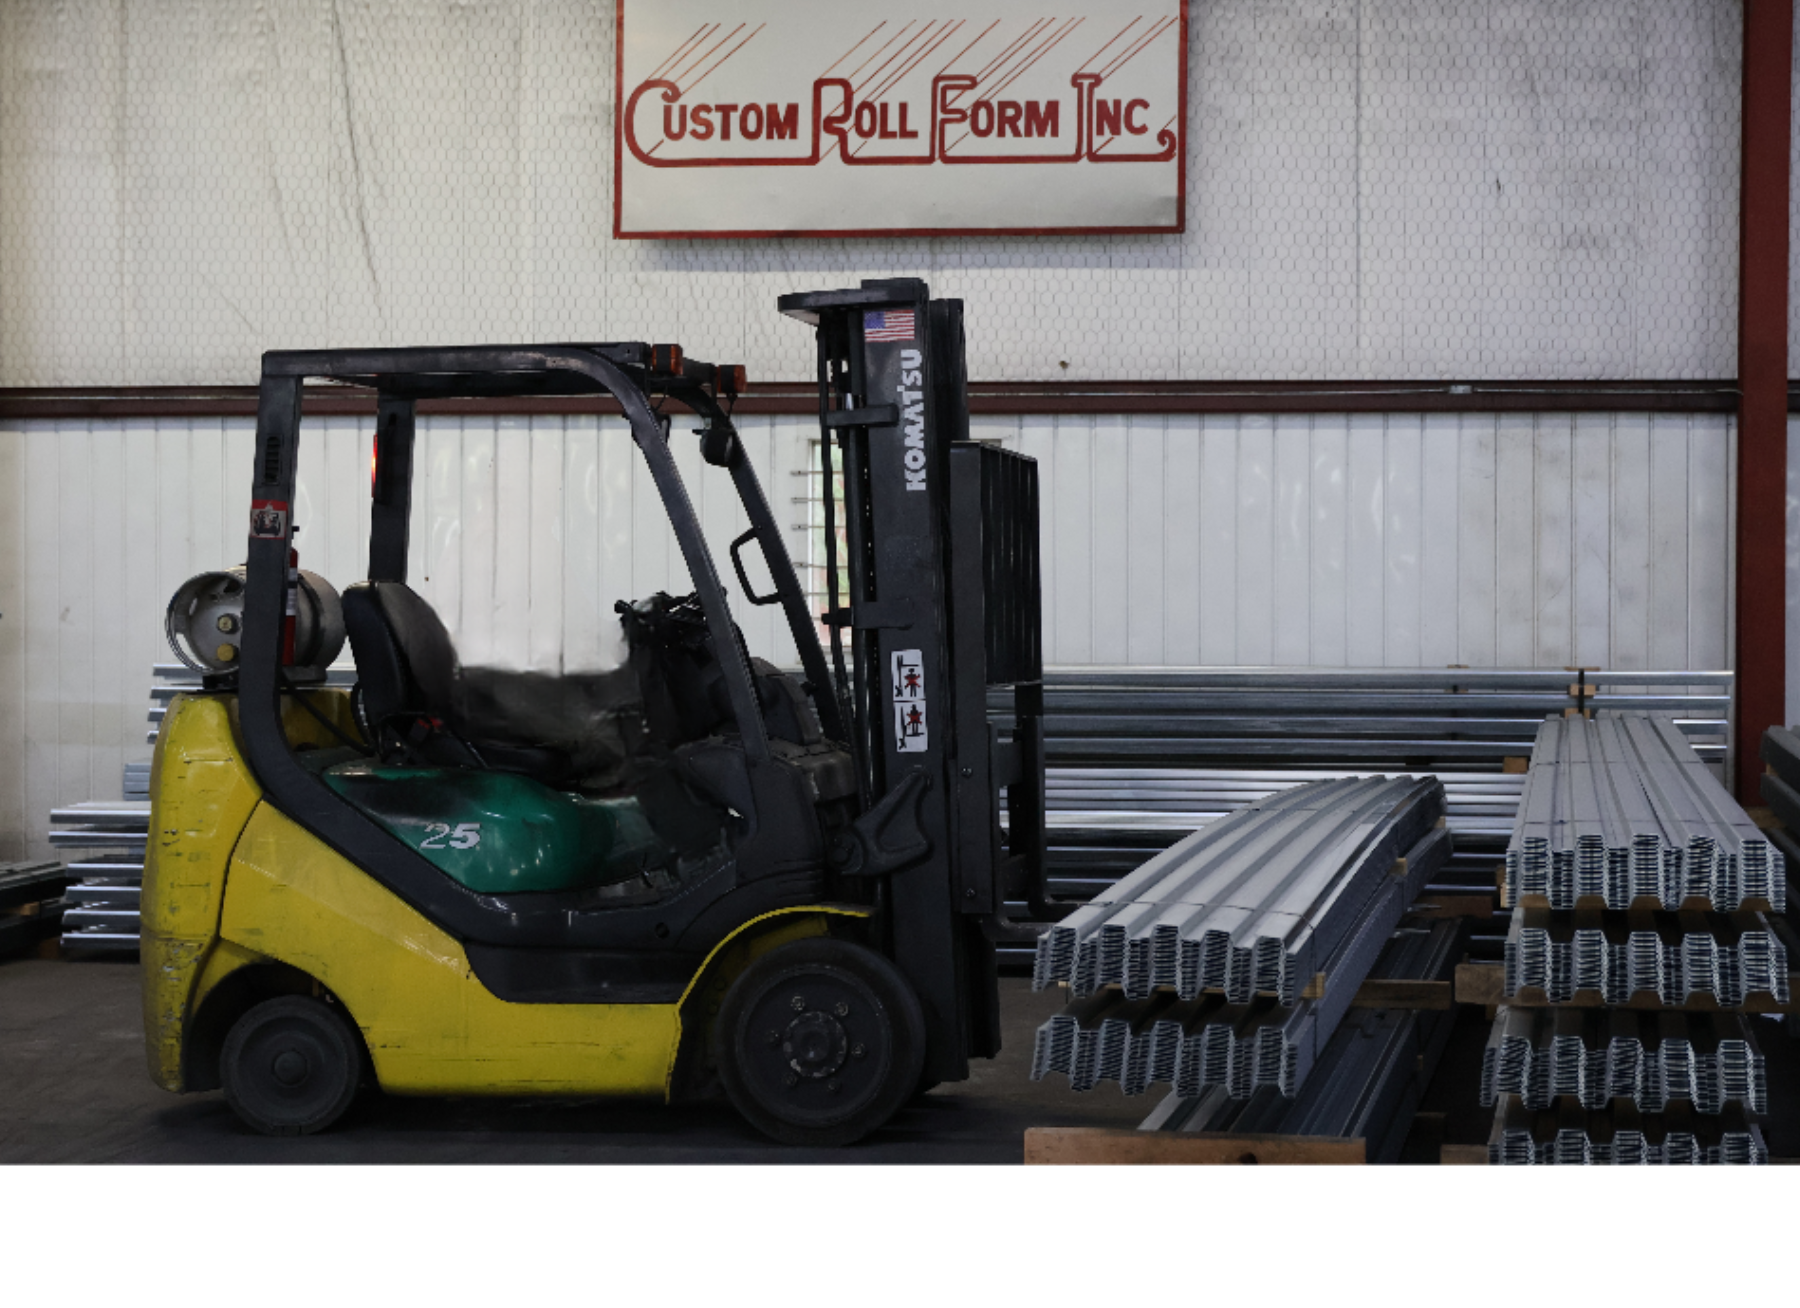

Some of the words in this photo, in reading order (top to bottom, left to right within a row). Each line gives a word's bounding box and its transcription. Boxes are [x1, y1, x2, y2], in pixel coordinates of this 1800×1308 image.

[624, 78, 799, 167] CUSTOM
[812, 77, 919, 165] ROLL
[931, 74, 1060, 164] FORM
[897, 348, 927, 491] KOMATSU
[420, 822, 481, 850] 25
